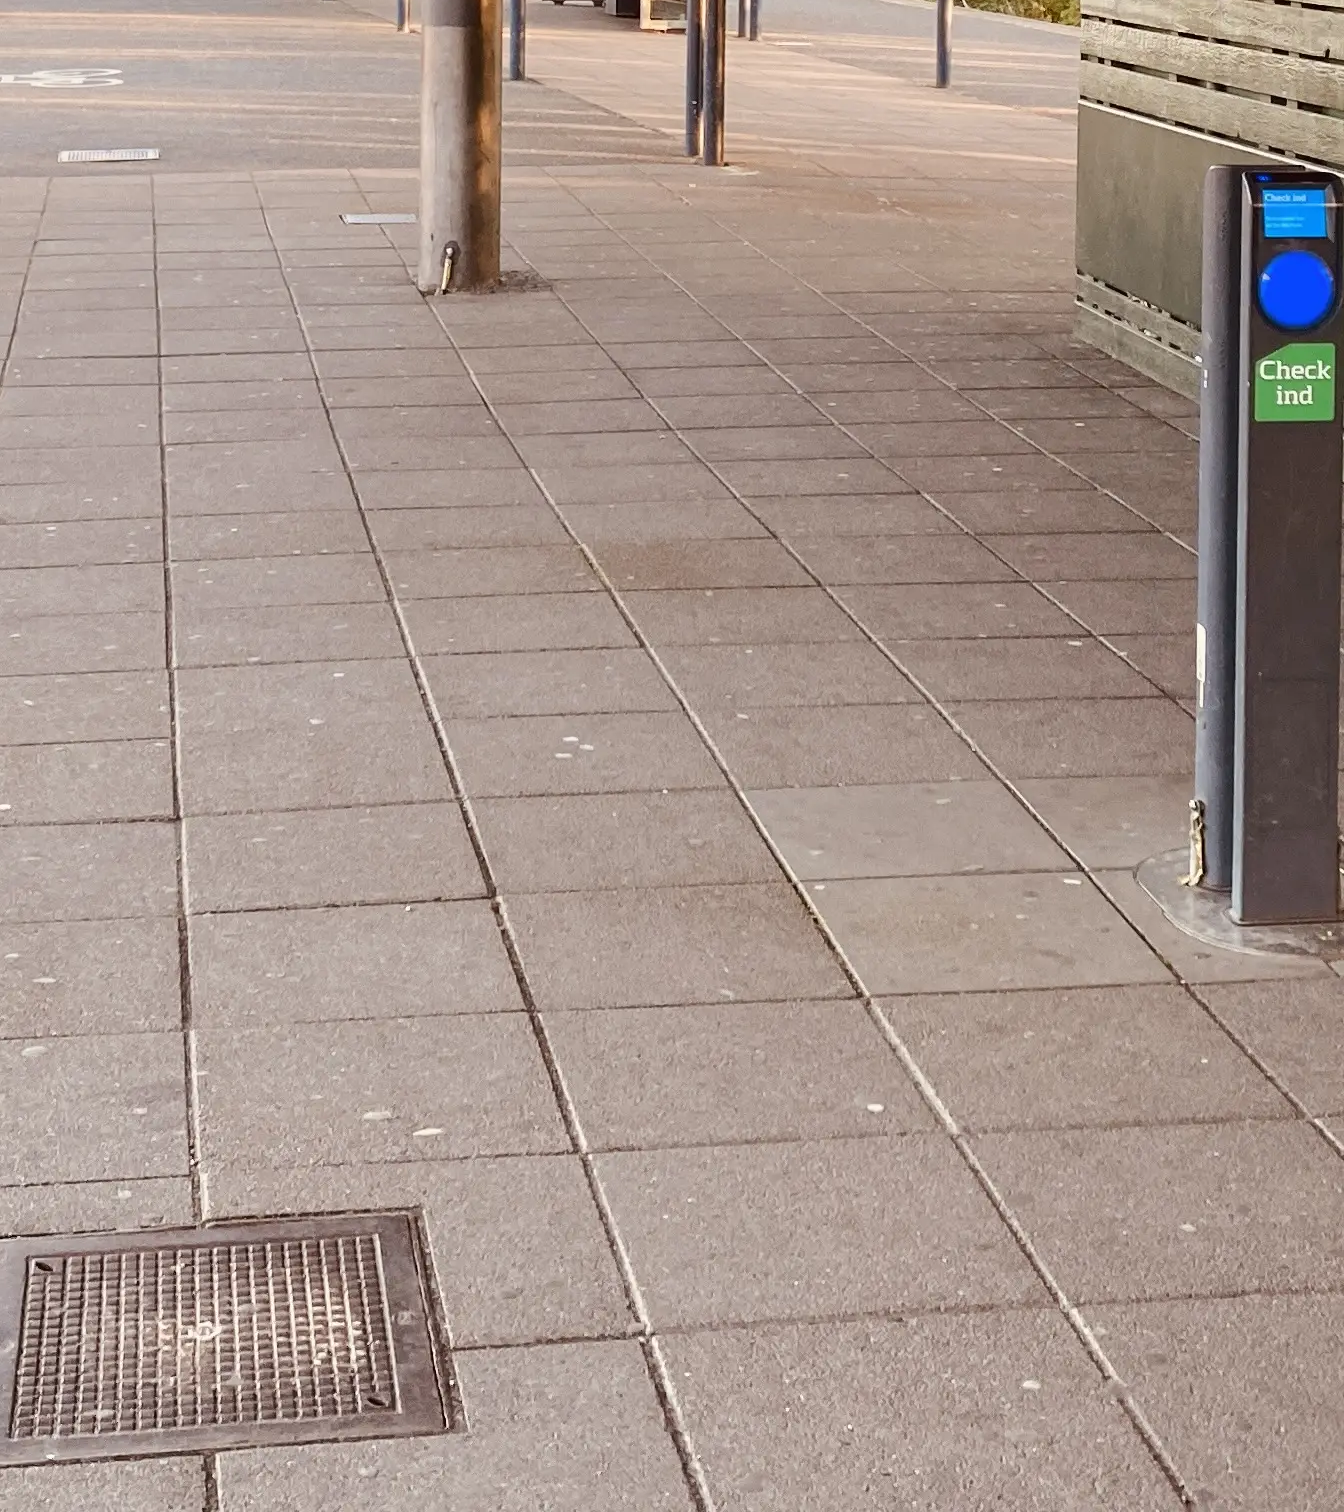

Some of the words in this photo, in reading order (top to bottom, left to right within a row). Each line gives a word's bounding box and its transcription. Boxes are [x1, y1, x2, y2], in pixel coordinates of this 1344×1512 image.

[1264, 193, 1291, 202] Check
[1292, 194, 1307, 202] ind
[1259, 360, 1331, 381] Check
[1276, 385, 1314, 406] ind
